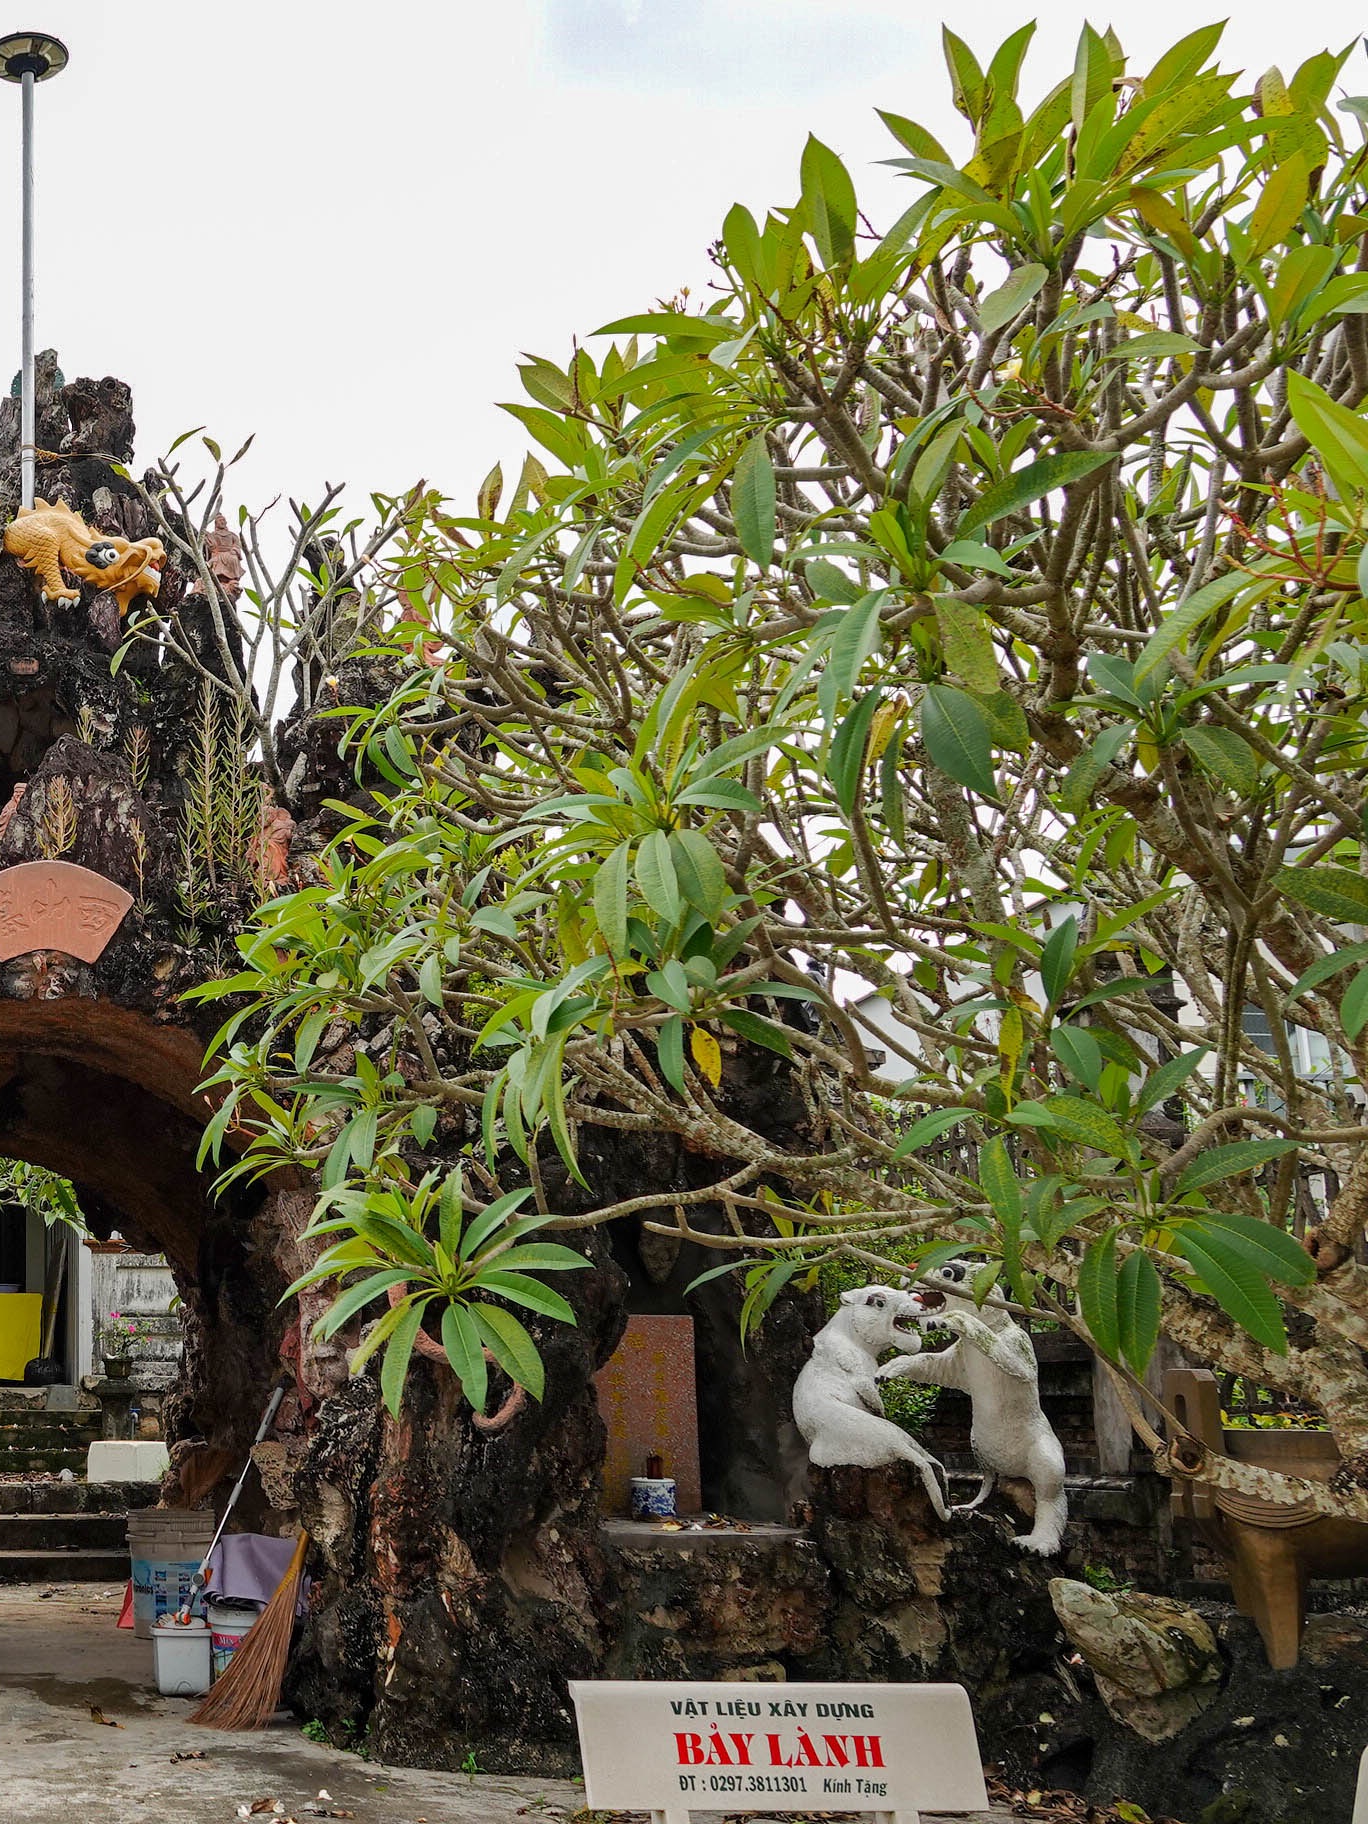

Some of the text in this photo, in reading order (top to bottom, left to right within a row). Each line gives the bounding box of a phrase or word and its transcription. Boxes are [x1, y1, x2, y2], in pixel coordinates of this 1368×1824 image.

[670, 1698, 875, 1721] VẬT LIỆU XÂY DỰNG
[673, 1722, 887, 1769] BẢY LÀNH
[710, 1775, 808, 1792] 0297.3811301
[823, 1778, 851, 1793] Kính
[855, 1779, 888, 1798] Tặng
